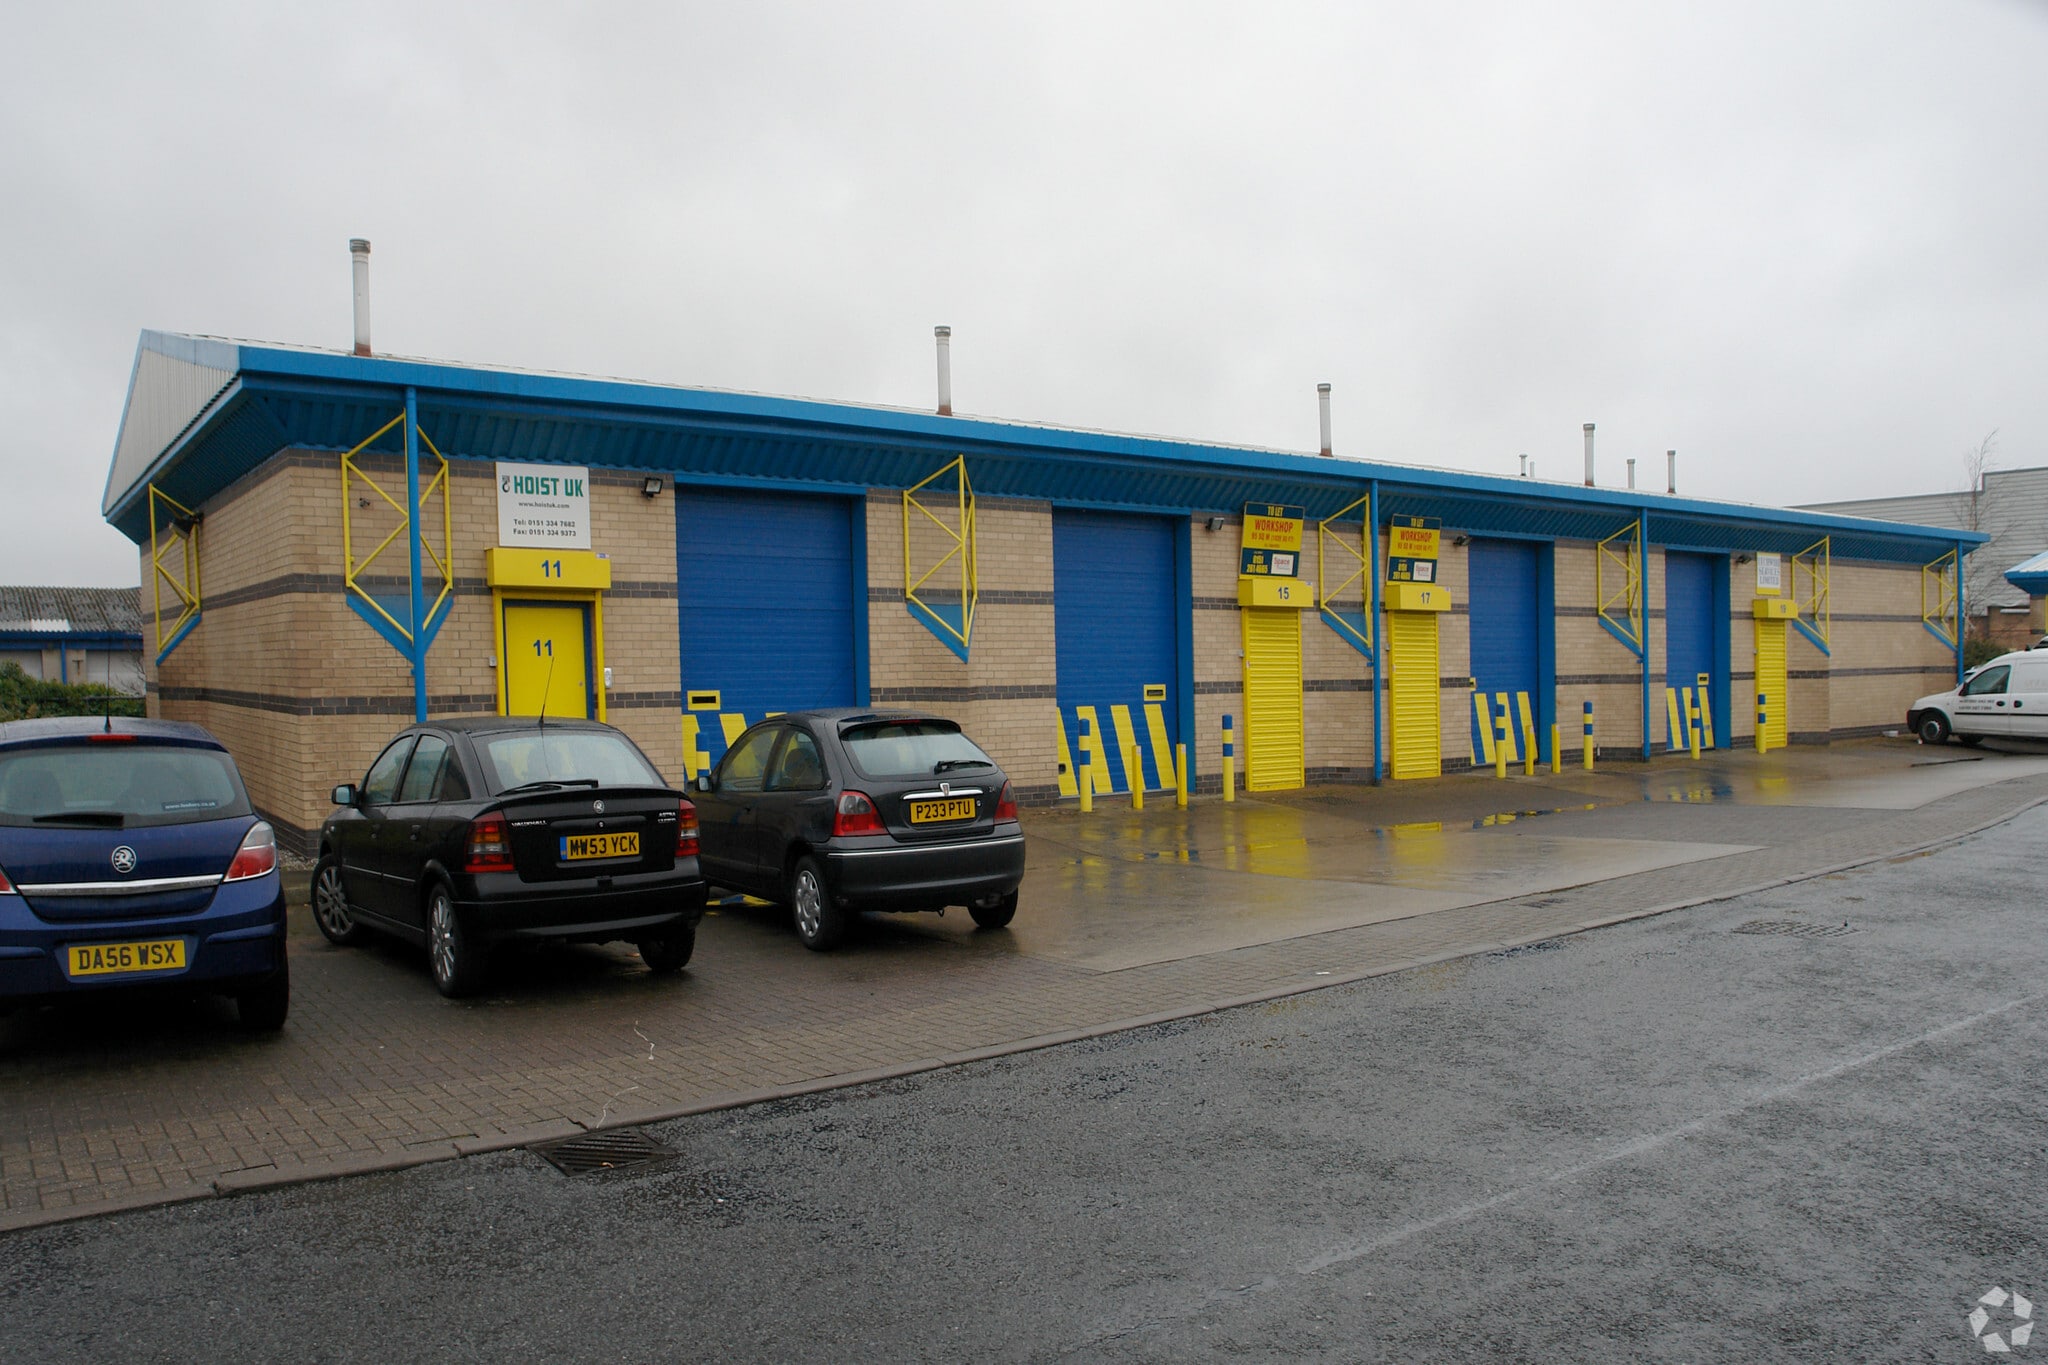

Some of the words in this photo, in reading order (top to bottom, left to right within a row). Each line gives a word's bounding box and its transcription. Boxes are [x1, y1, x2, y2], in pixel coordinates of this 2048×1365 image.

[513, 475, 559, 496] HOIST
[564, 478, 584, 497] UK
[518, 501, 570, 509] www.hoistuk.com
[1255, 519, 1294, 533] WORKSHOP
[1400, 530, 1432, 542] WORKSHOP
[541, 559, 561, 578] 11
[1277, 587, 1290, 600] 15
[1421, 592, 1430, 604] 17
[533, 639, 553, 657] 11
[916, 803, 947, 820] P233
[949, 800, 971, 817] PTU
[570, 838, 607, 857] MW53
[611, 835, 637, 853] YCK
[78, 946, 132, 970] DA56
[138, 943, 177, 966] WSX
